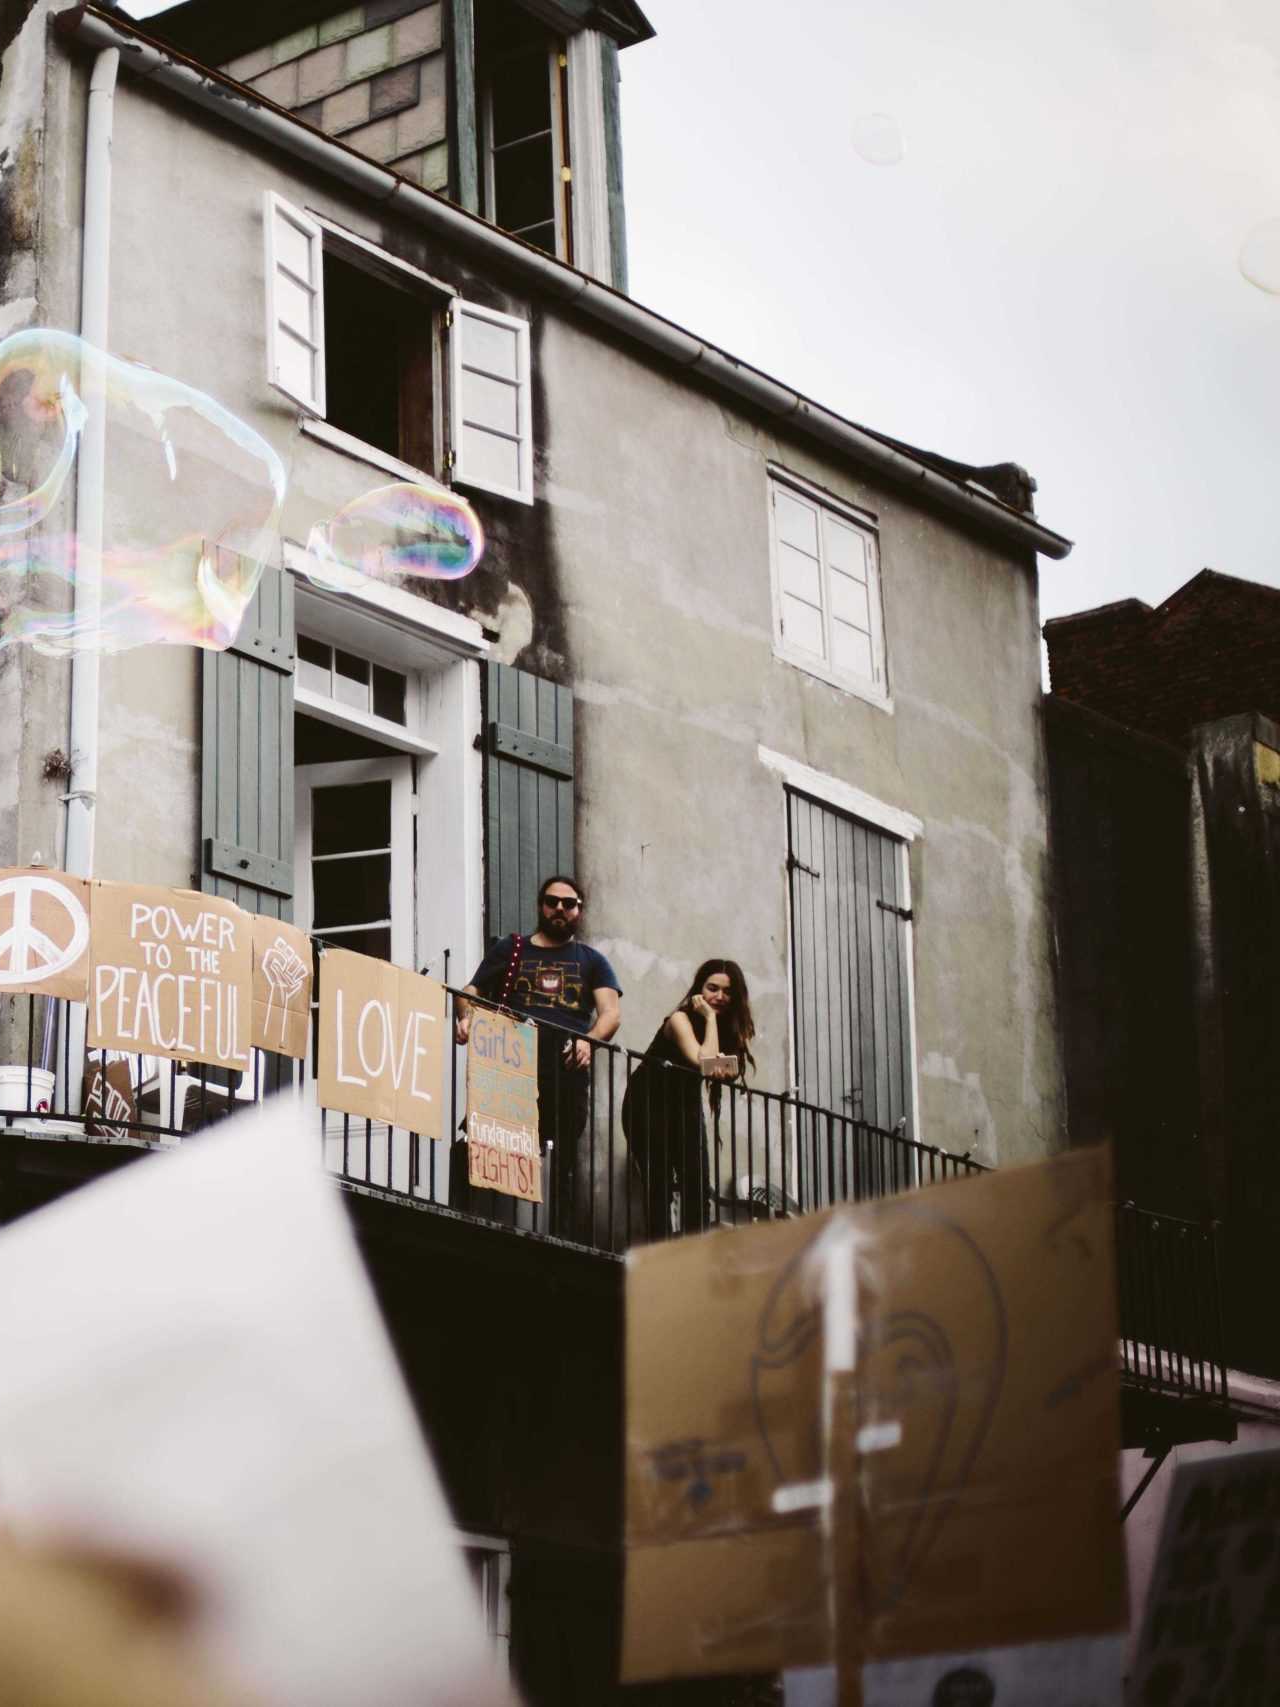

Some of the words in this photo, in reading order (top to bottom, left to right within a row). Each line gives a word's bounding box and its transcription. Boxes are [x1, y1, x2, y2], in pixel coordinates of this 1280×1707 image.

[131, 903, 236, 952] POWER
[140, 941, 172, 970] TO
[186, 946, 221, 974] THE
[95, 964, 249, 1061] PEACEFUL
[336, 988, 437, 1103] LOVE
[469, 1140, 534, 1195] RIGHTS!
